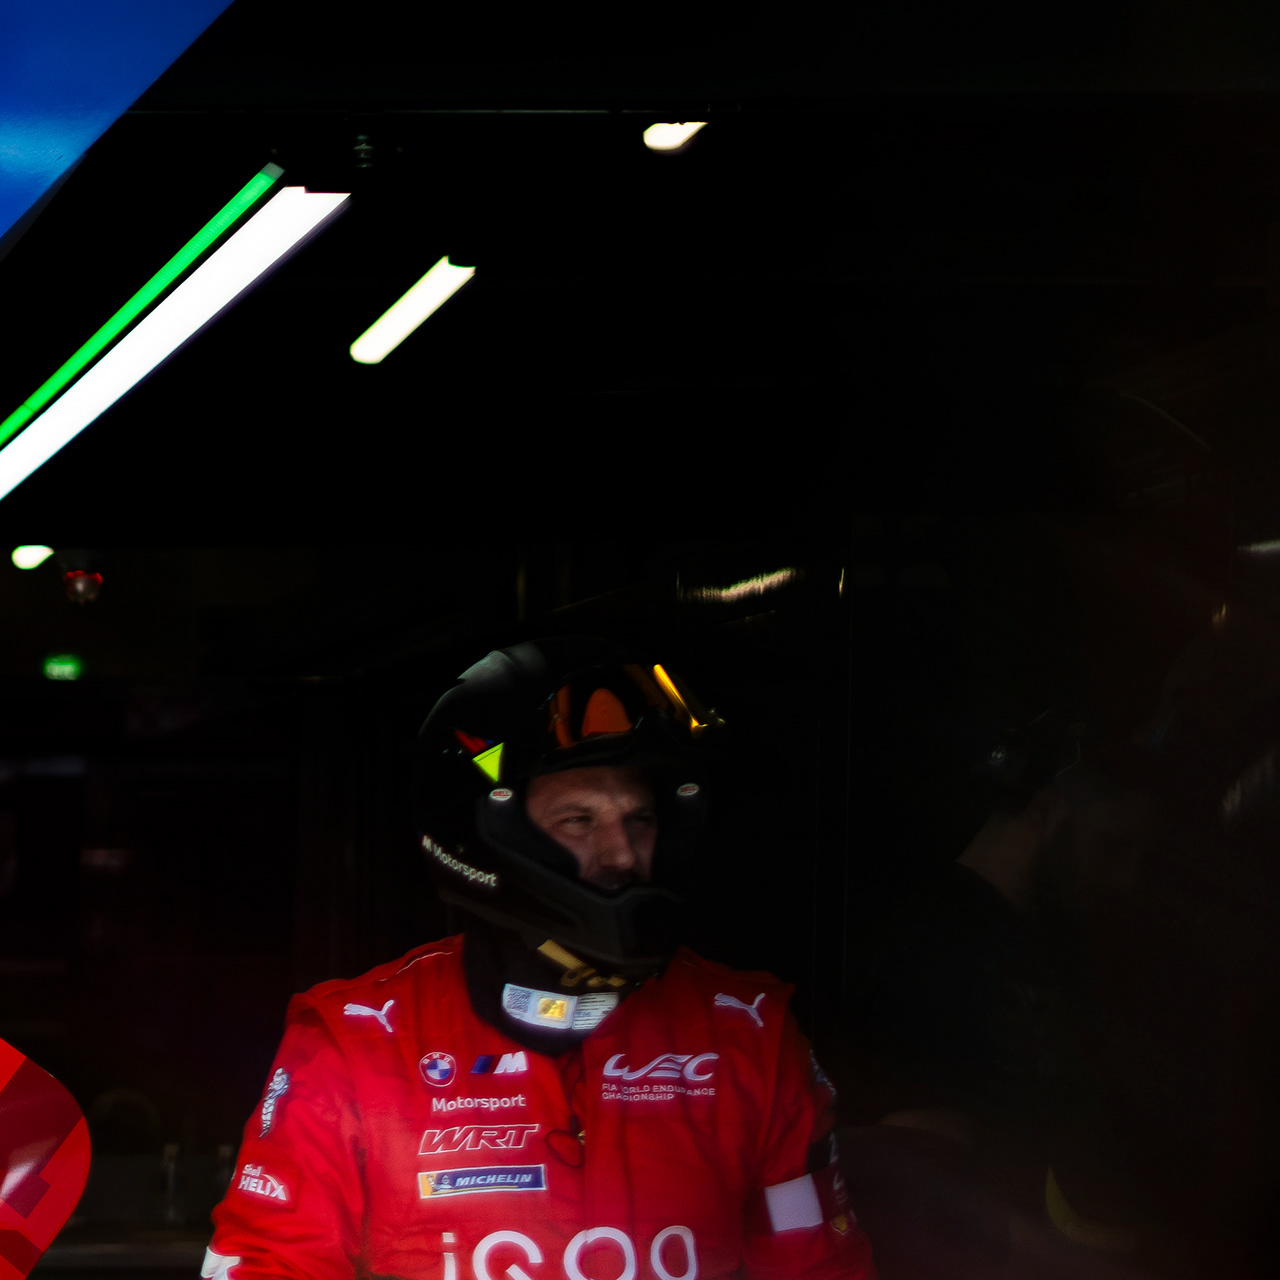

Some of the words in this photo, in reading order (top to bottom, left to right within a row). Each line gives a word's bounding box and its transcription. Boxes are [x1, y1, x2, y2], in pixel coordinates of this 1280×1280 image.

[433, 843, 497, 887] Motorsport
[603, 1052, 720, 1081] WEC
[601, 1083, 618, 1091] FIA
[619, 1084, 651, 1094] ORLD
[601, 1092, 675, 1102] CHAPIONSHIP
[431, 1094, 527, 1112] Motorsport
[418, 1124, 539, 1155] WRT
[237, 1174, 287, 1201] HELIX
[455, 1173, 533, 1187] MICHELIN
